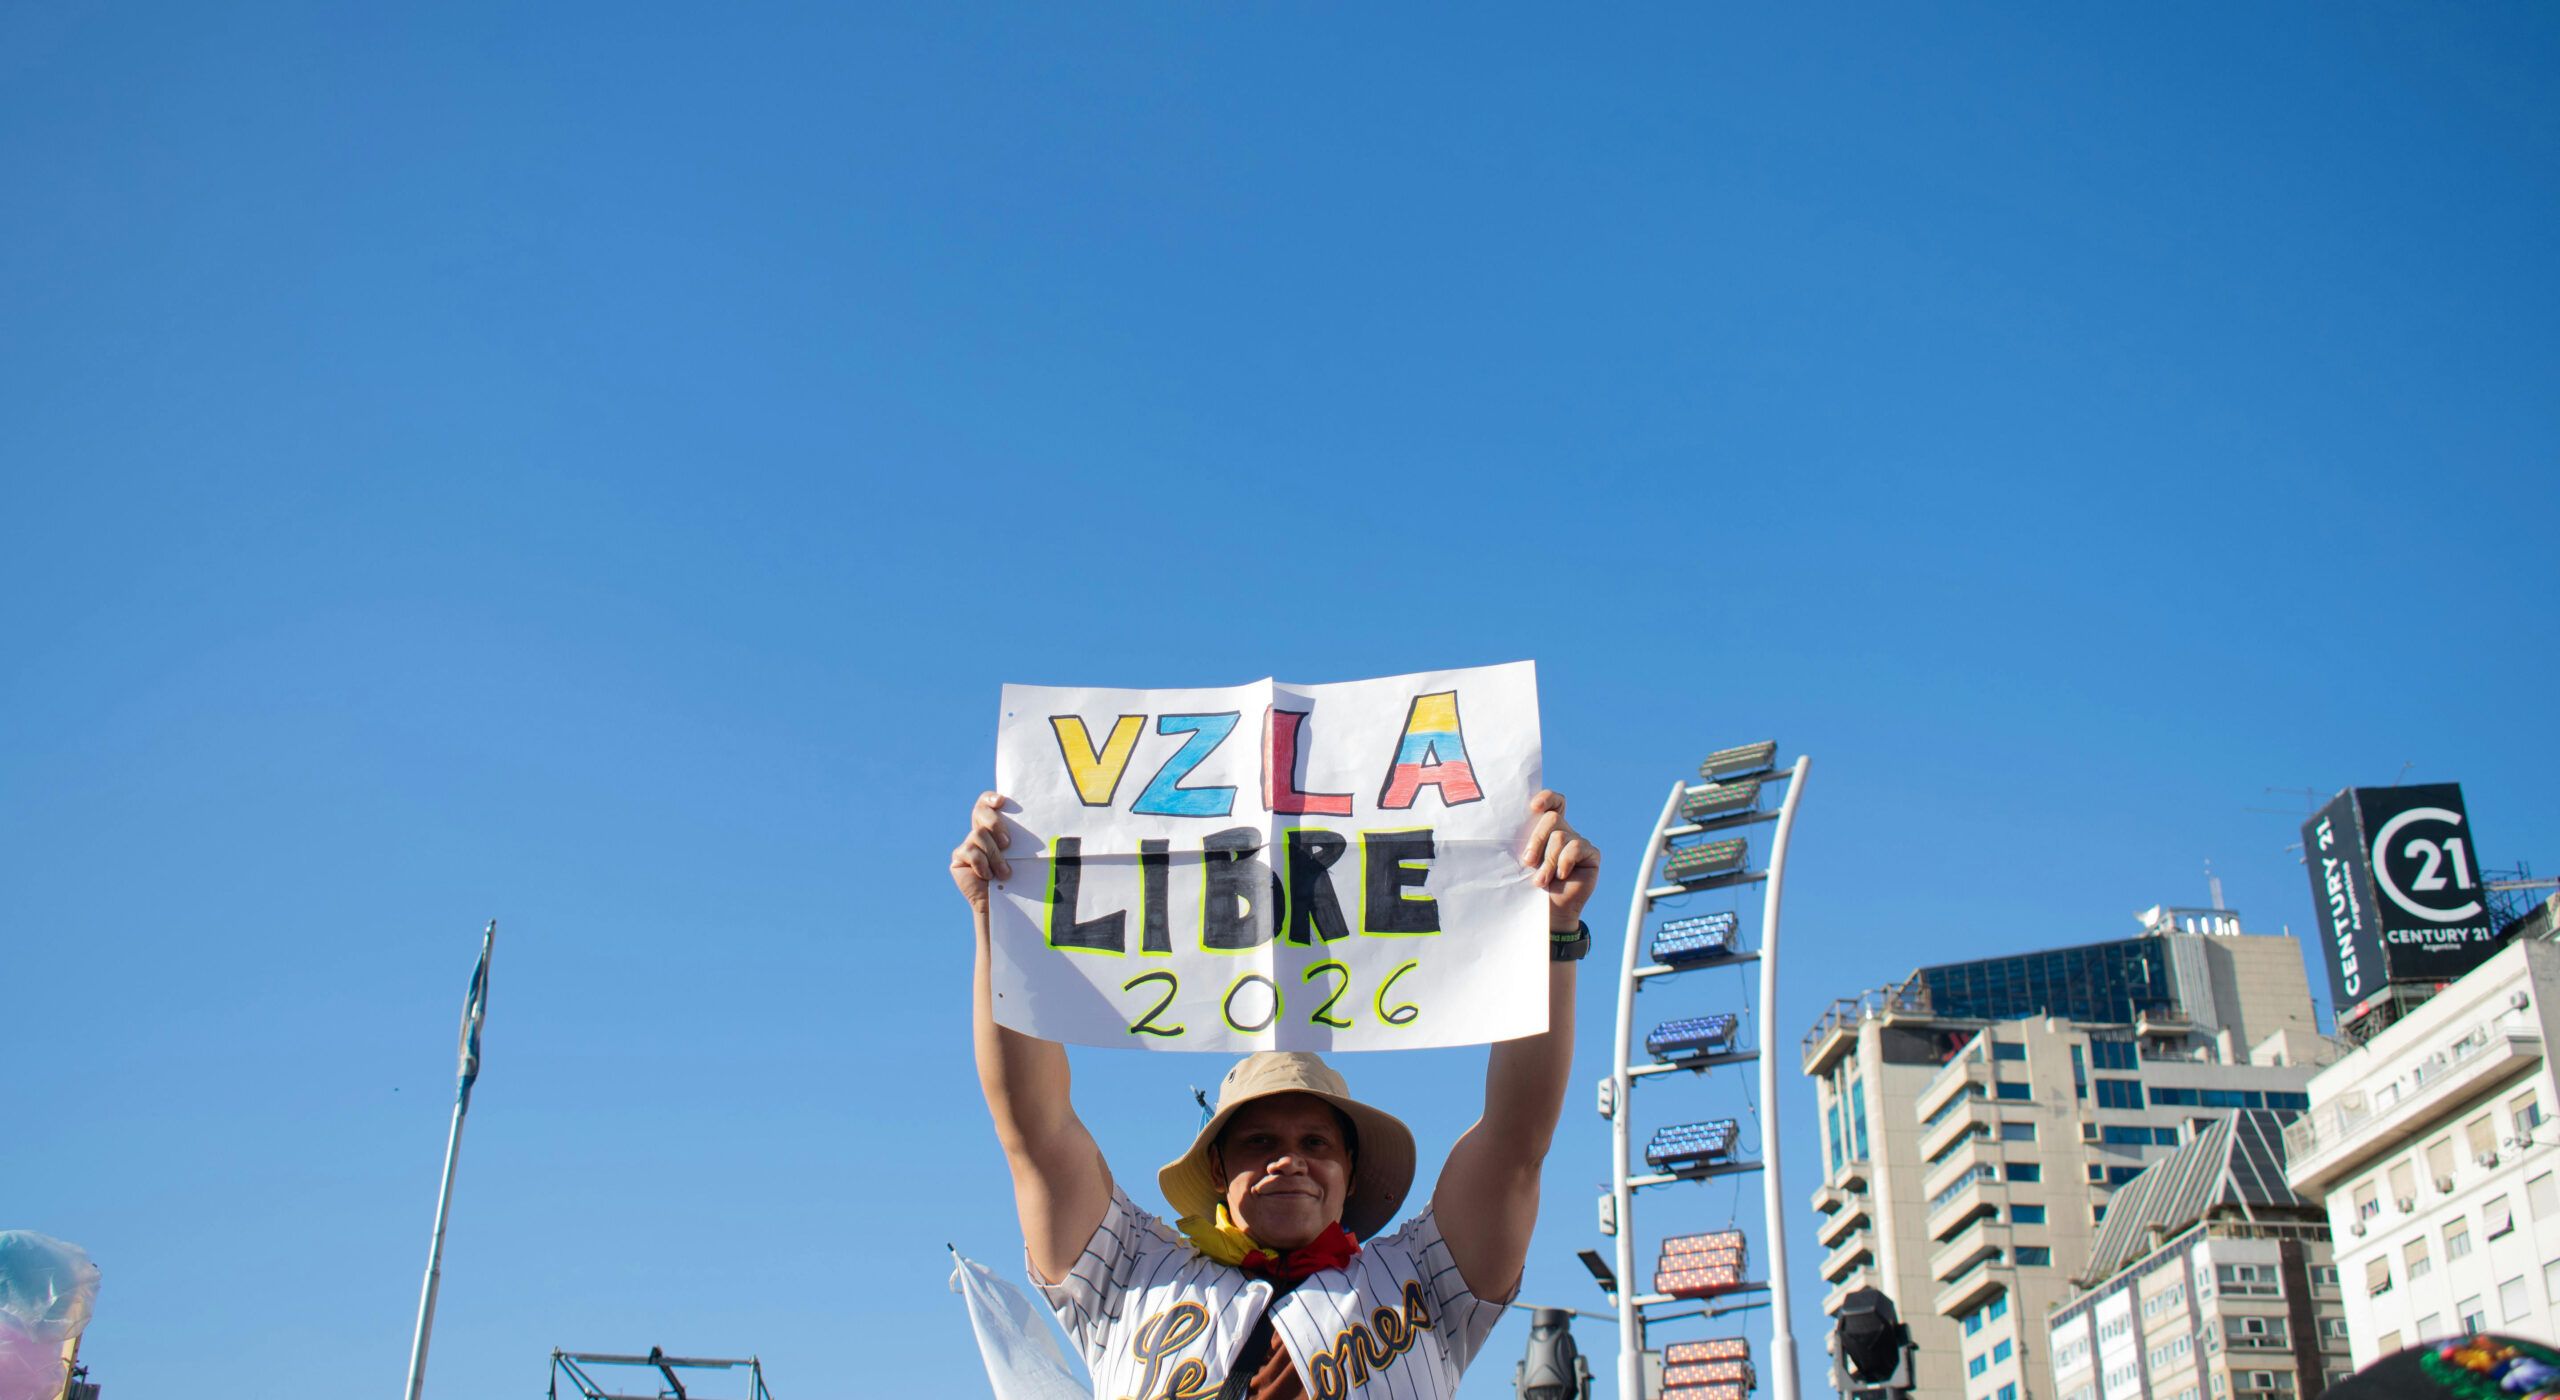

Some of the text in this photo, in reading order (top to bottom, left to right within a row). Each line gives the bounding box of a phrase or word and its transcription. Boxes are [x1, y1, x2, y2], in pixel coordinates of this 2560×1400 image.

[1048, 690, 1485, 817] VZLA
[1045, 826, 1441, 957] LIBRE
[2316, 816, 2361, 996] CENTURY 21
[2387, 927, 2491, 944] CENTURY 21
[1123, 960, 1420, 1036] 2026
